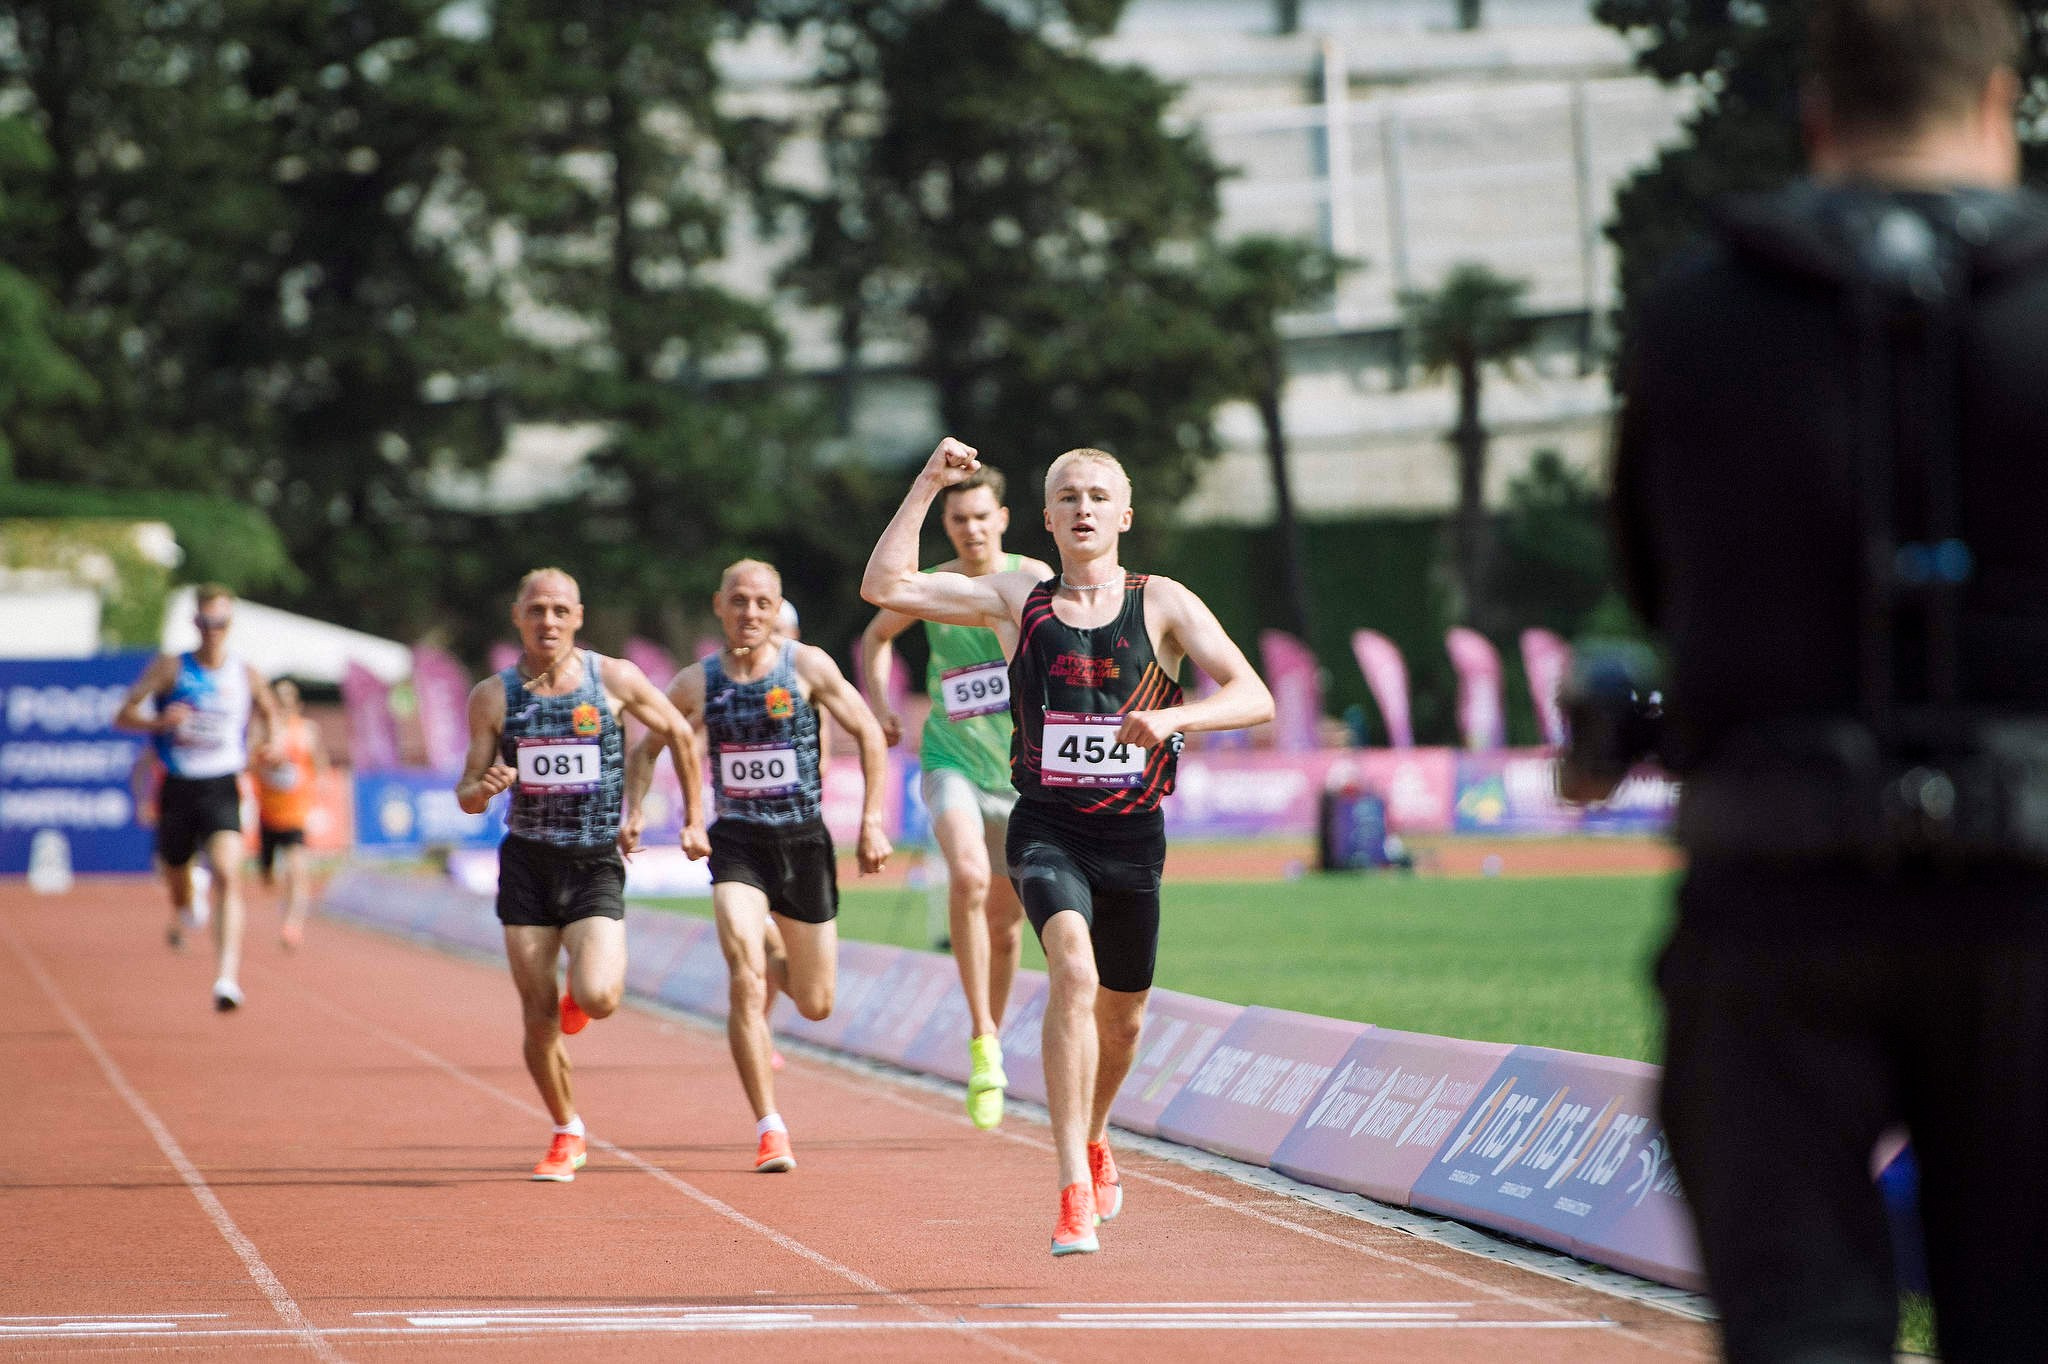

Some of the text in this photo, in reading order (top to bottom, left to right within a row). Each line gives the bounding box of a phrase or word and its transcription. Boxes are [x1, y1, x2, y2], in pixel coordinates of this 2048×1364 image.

[1049, 664, 1120, 678] ДЫХАНИЕ
[1056, 654, 1114, 667] ВТОРОЕ
[955, 677, 1004, 702] 599
[1058, 735, 1130, 763] 454
[534, 754, 584, 776] 081
[732, 759, 785, 780] 080
[1470, 1093, 1539, 1158] ПСБ
[1521, 1103, 1592, 1170] ПСБ
[1576, 1113, 1649, 1186] ПСБ
